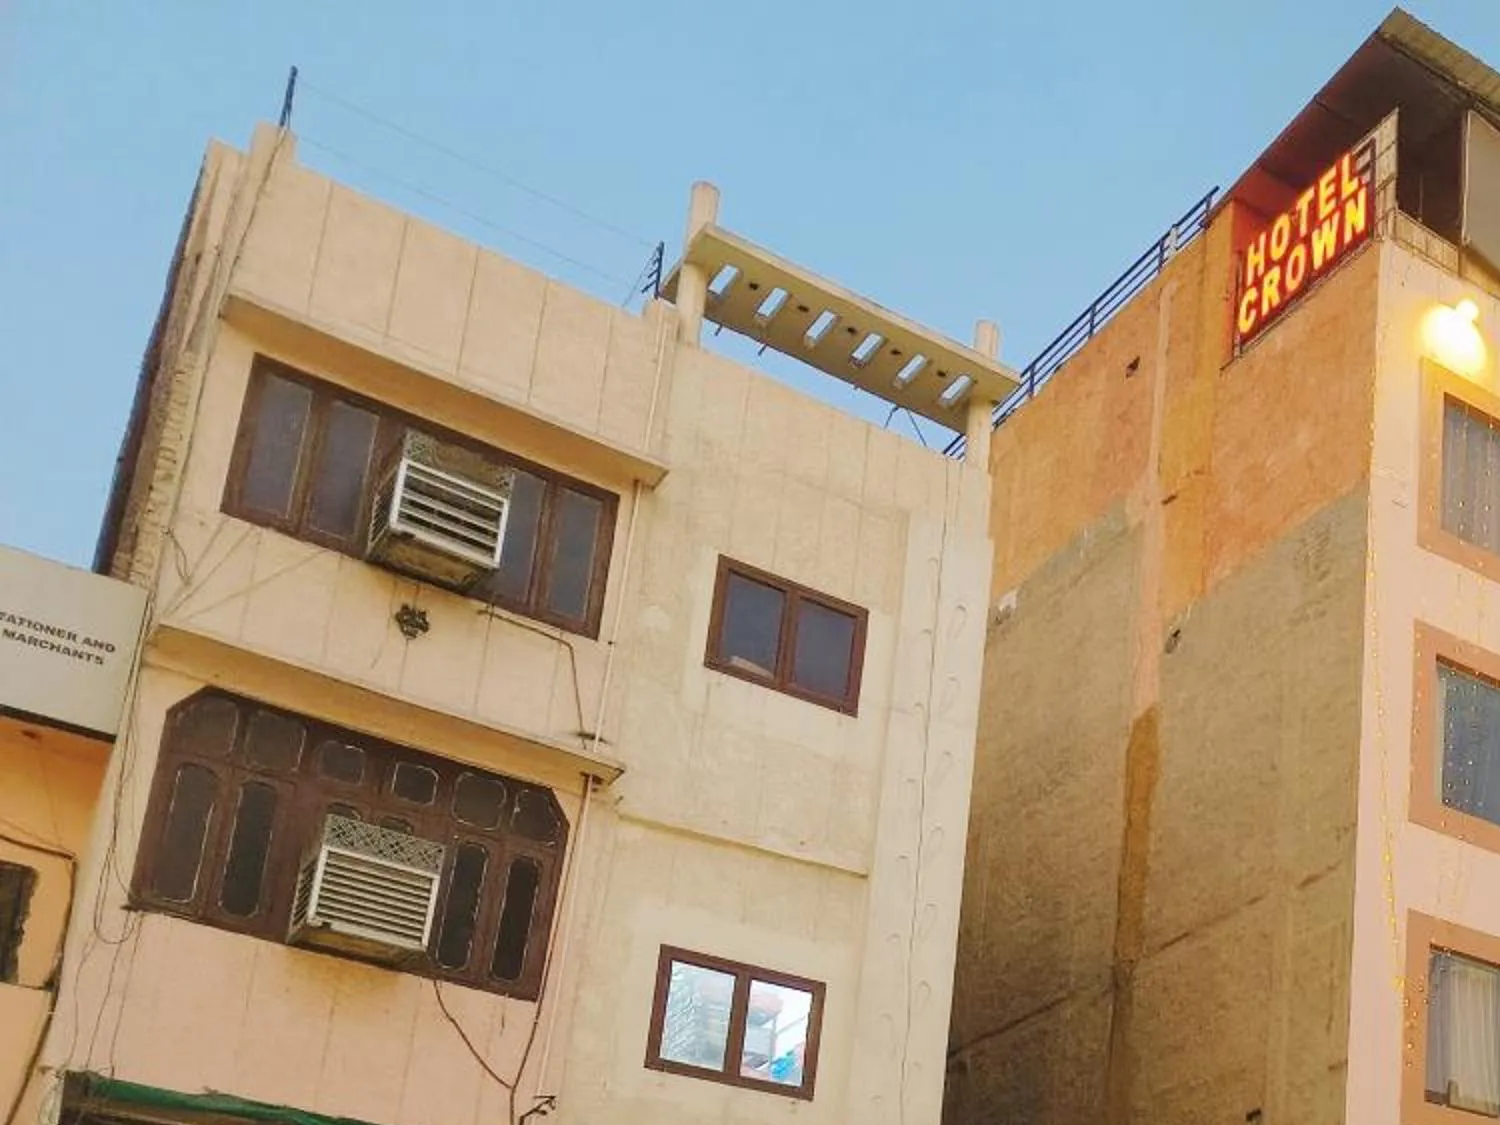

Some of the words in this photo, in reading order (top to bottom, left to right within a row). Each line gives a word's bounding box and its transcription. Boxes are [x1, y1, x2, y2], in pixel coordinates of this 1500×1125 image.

[1238, 187, 1367, 333] CROWN
[1248, 153, 1358, 286] HOTEL
[82, 636, 116, 653] AND
